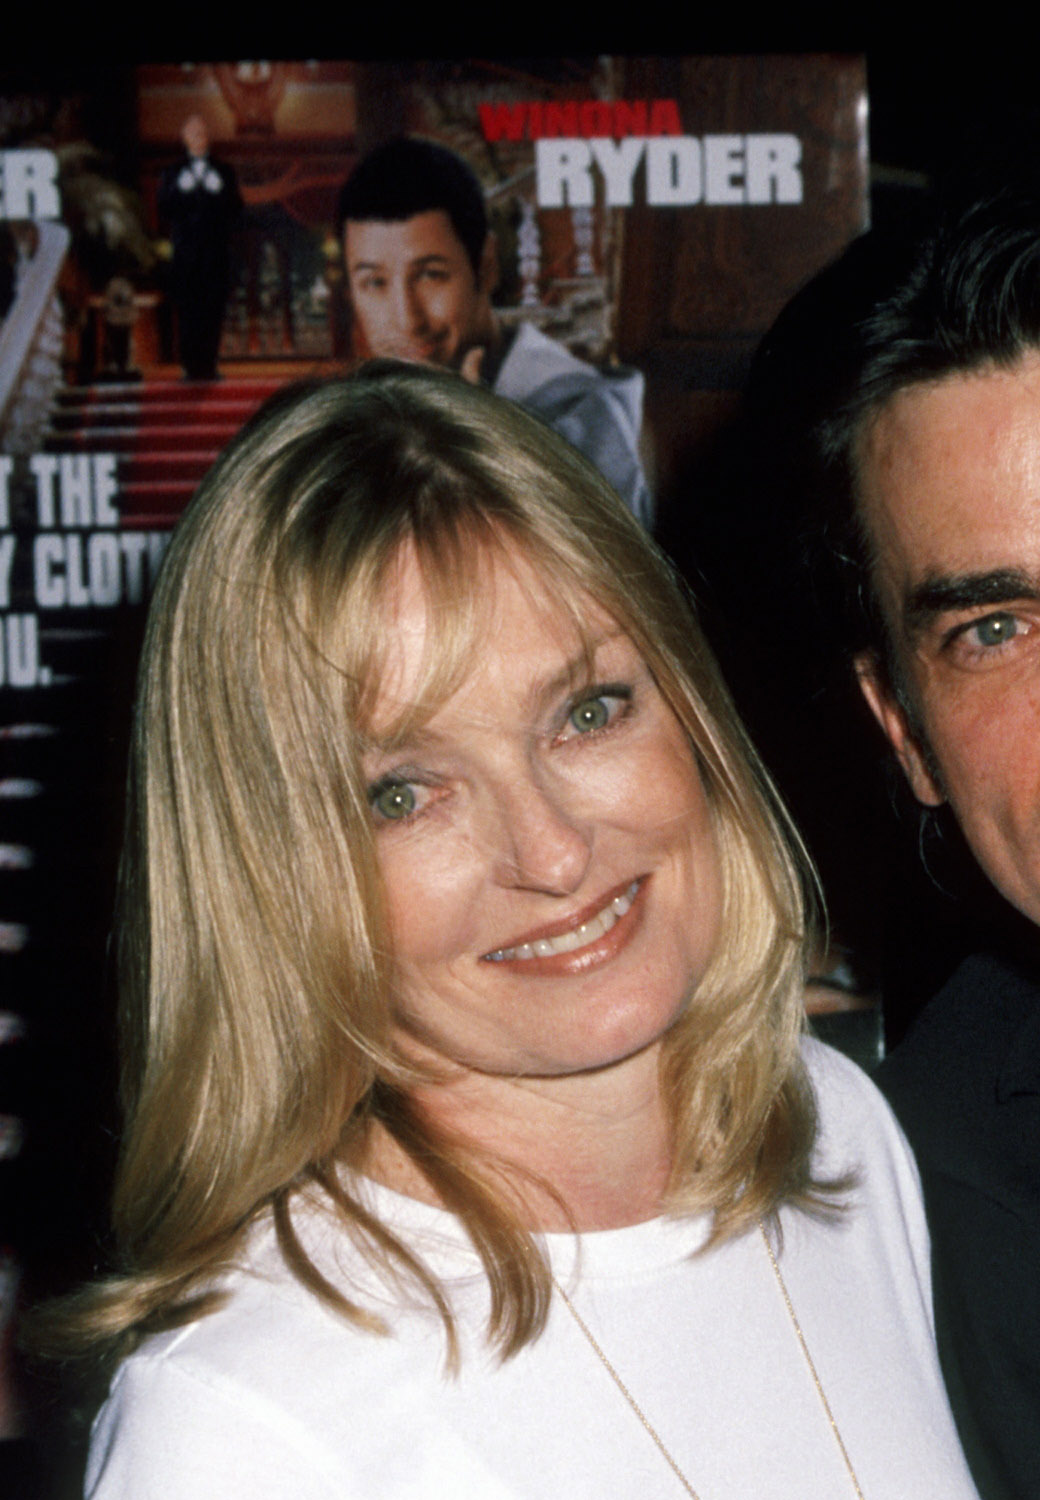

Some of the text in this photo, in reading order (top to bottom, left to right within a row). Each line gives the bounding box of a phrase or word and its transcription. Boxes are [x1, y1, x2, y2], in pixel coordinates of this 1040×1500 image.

[477, 99, 684, 141] WINONA
[536, 133, 803, 208] RYDER
[30, 452, 119, 528] THE
